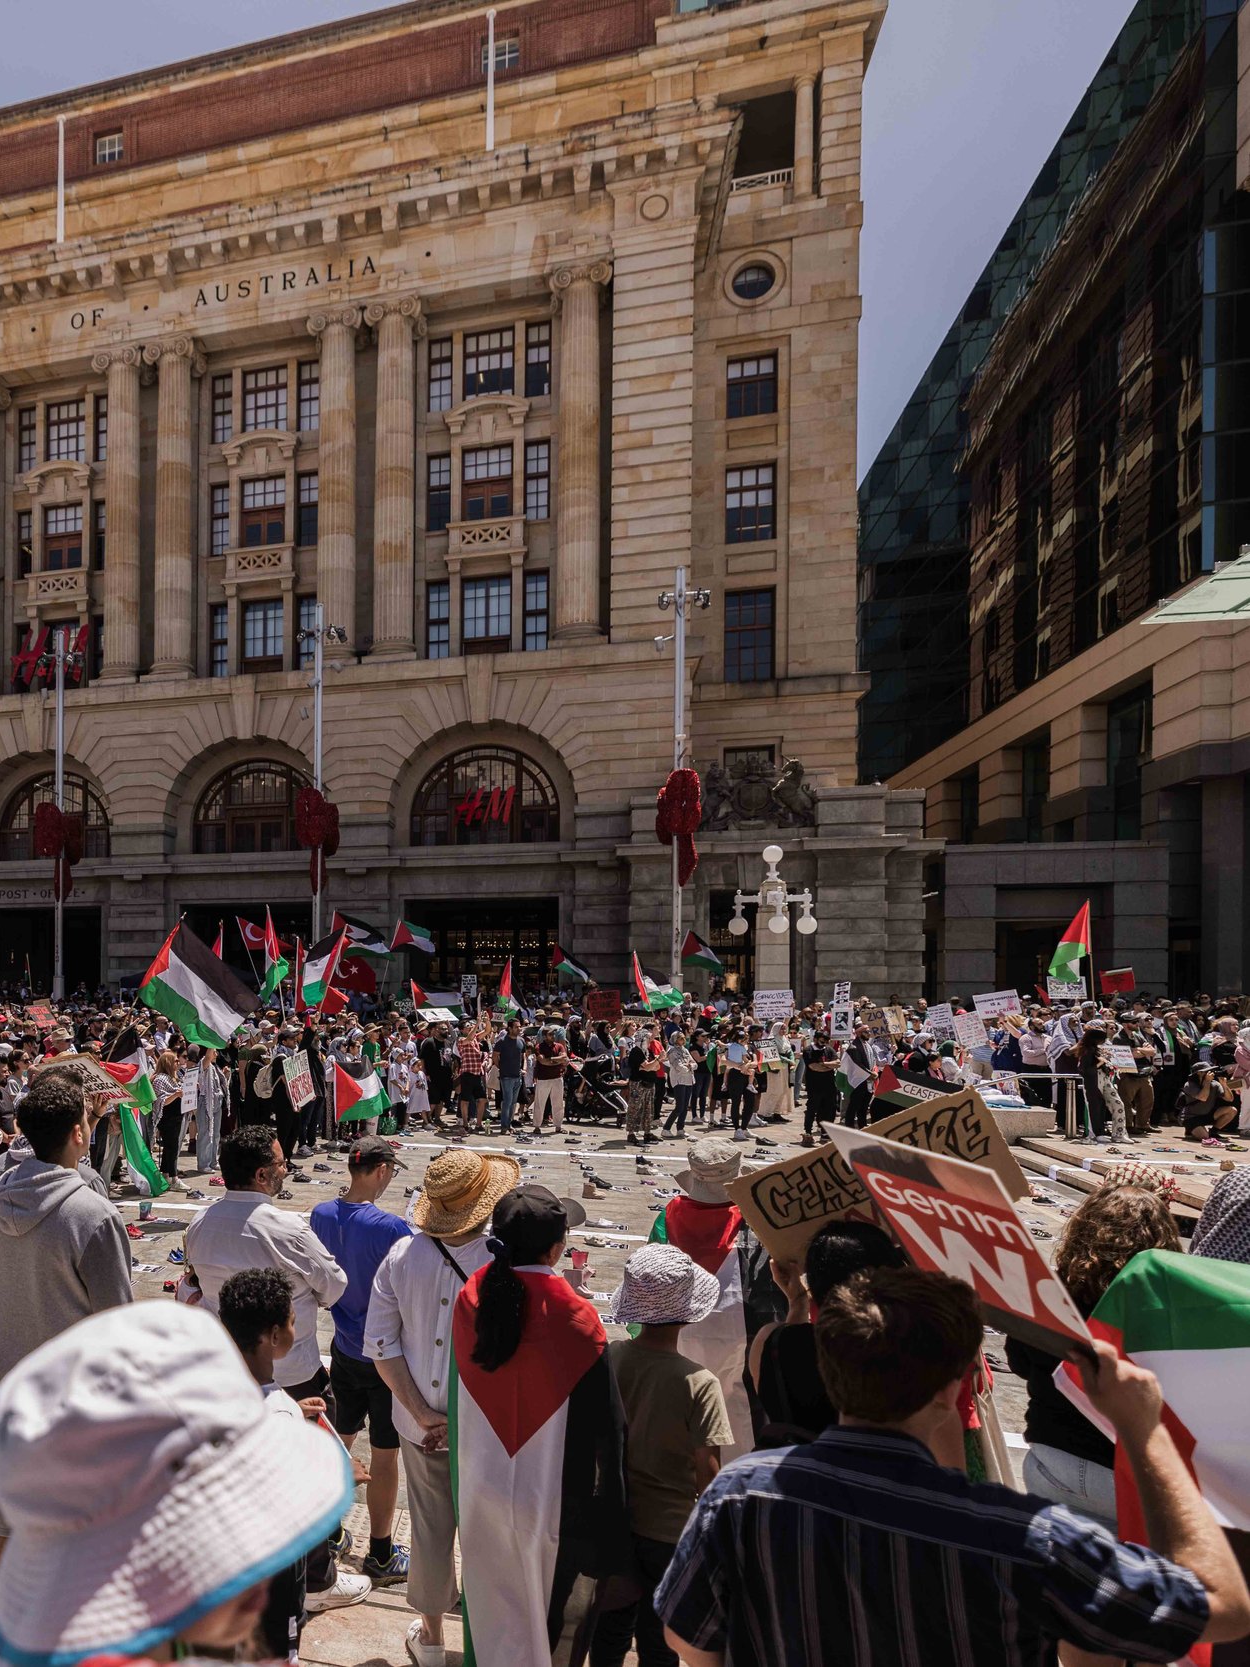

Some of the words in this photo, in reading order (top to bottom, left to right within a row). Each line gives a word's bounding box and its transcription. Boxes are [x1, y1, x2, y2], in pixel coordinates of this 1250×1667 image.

[71, 308, 104, 330] OF
[194, 256, 377, 308] AUSTRALIA
[902, 1083, 944, 1100] CEASEF
[751, 1099, 991, 1230] CEASFIRE
